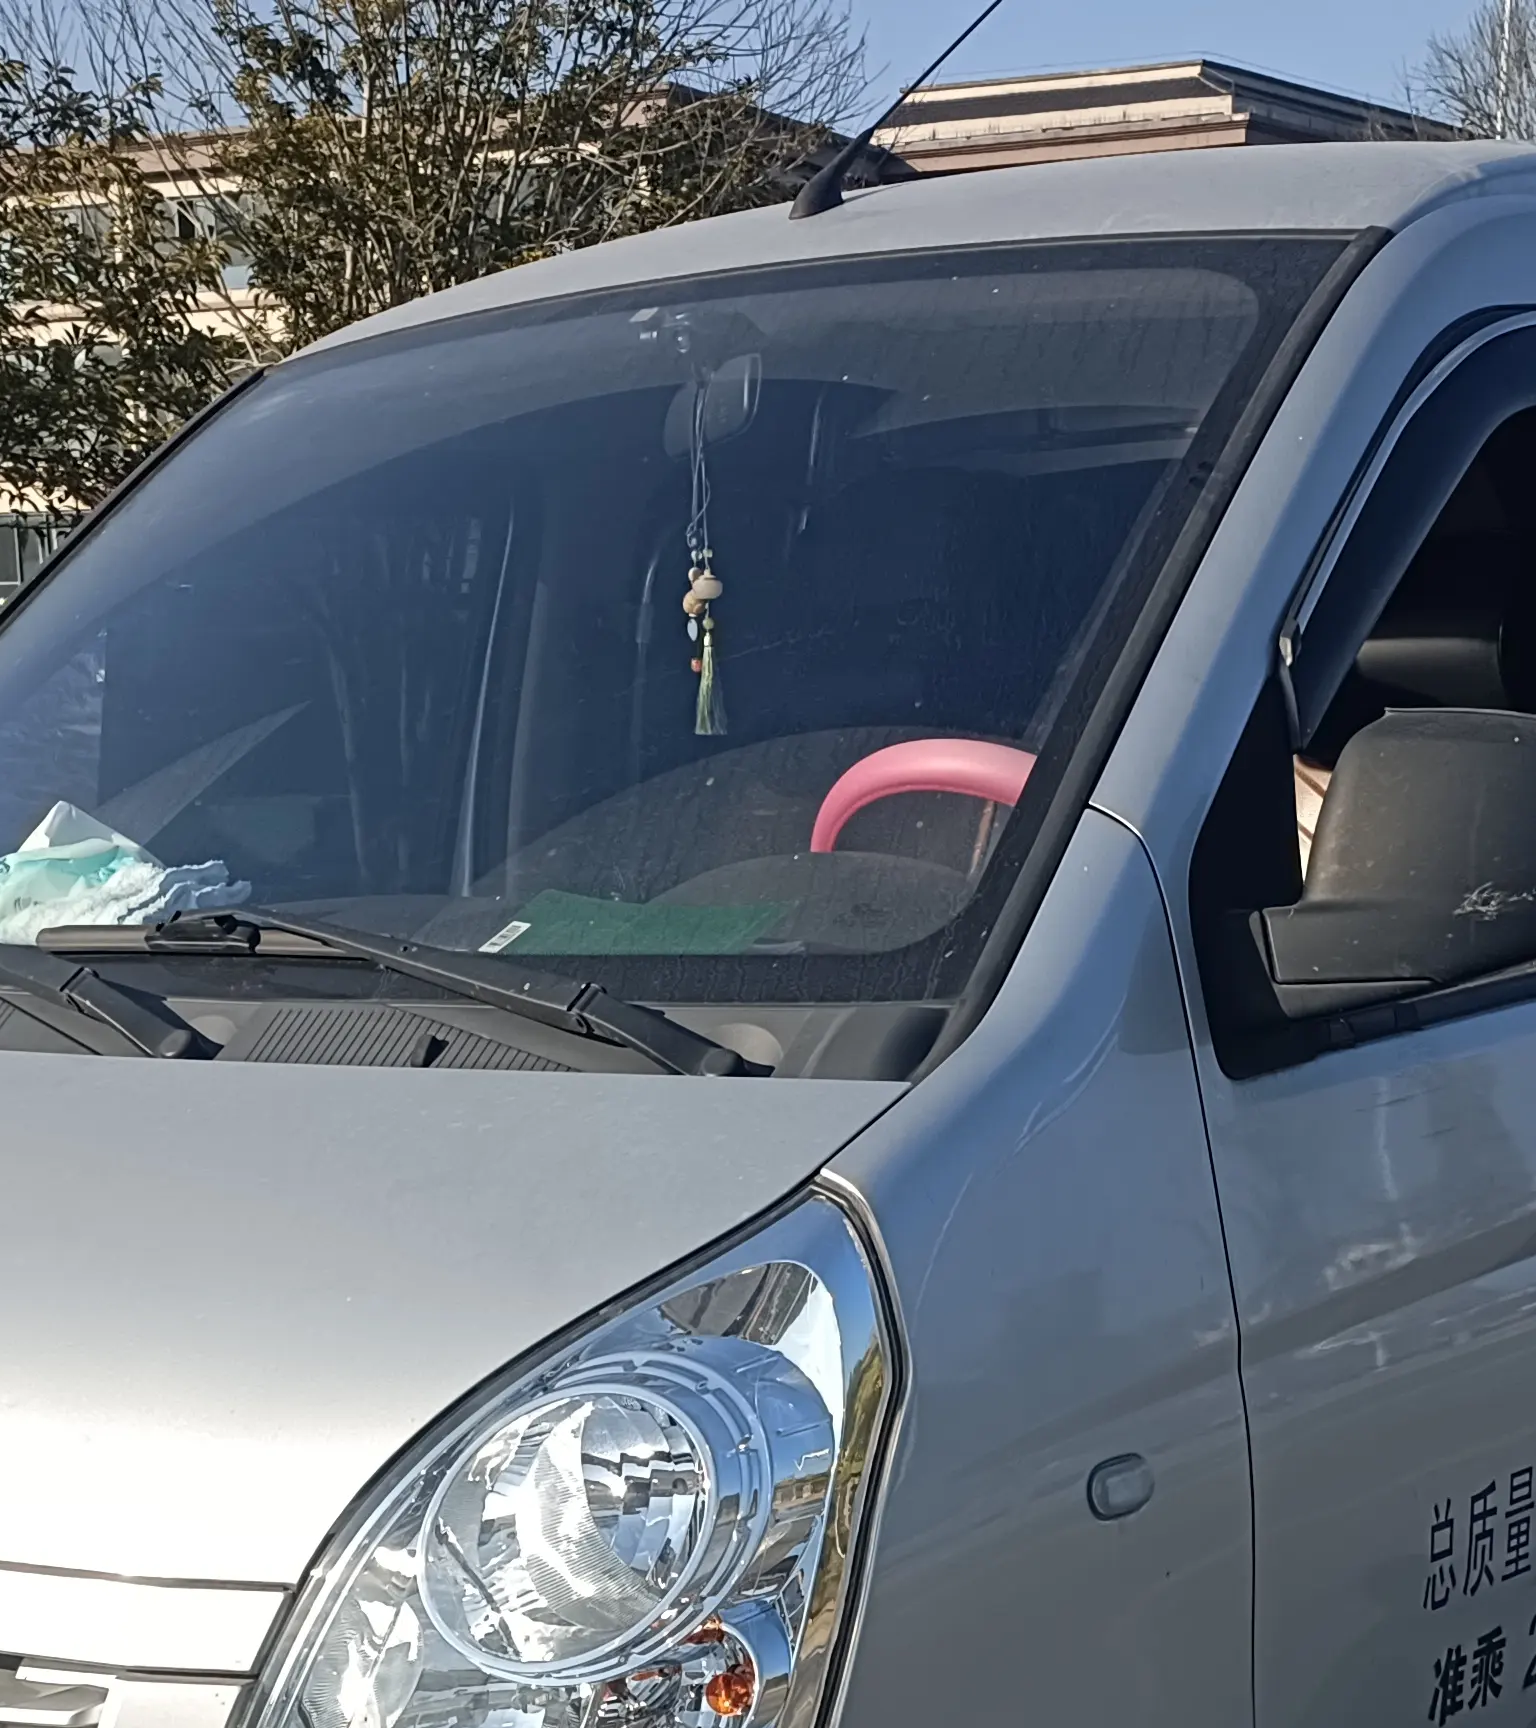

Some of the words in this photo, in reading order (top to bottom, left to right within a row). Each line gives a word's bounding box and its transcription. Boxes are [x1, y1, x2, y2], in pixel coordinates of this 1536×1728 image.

[1422, 1465, 1535, 1611] 总质量
[1427, 1625, 1507, 1728] 准乘
